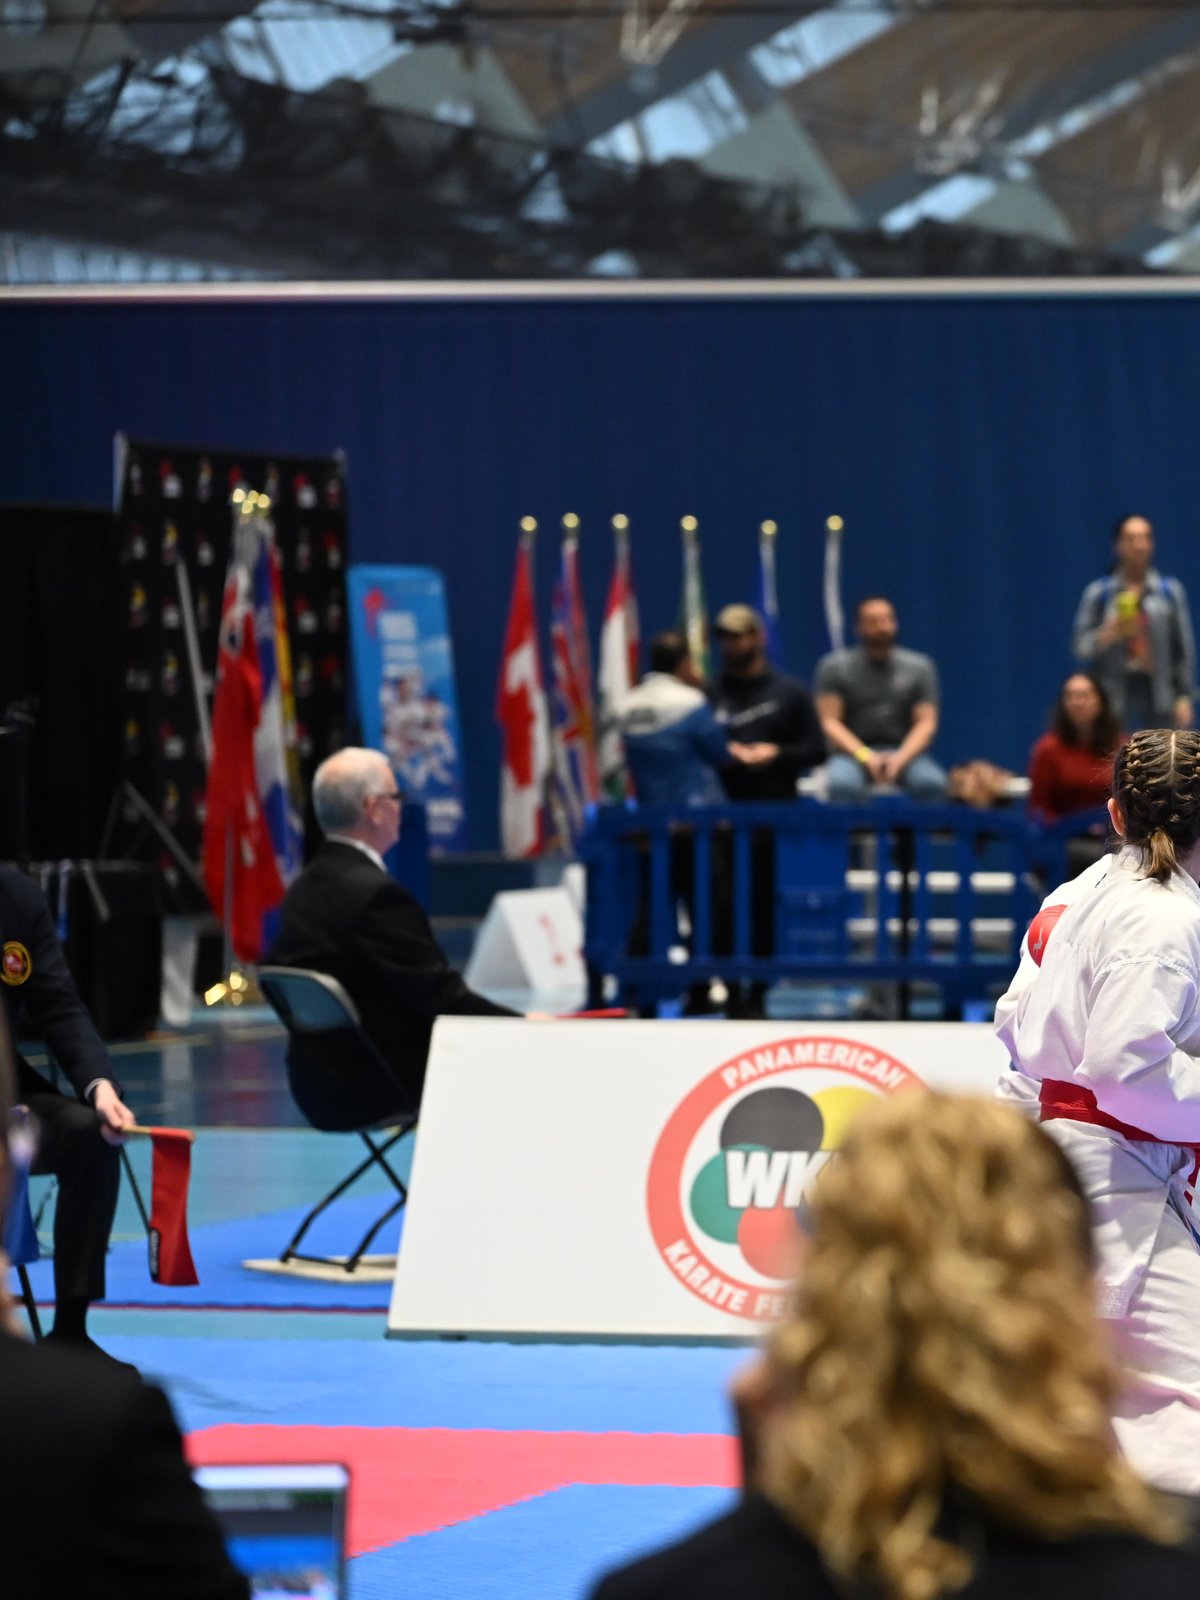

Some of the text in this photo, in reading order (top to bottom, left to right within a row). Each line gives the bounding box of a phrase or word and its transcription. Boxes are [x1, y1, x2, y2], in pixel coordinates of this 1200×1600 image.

[721, 1043, 908, 1089] PANAMERICAN
[725, 1150, 836, 1209] WK
[664, 1239, 748, 1313] KARATE
